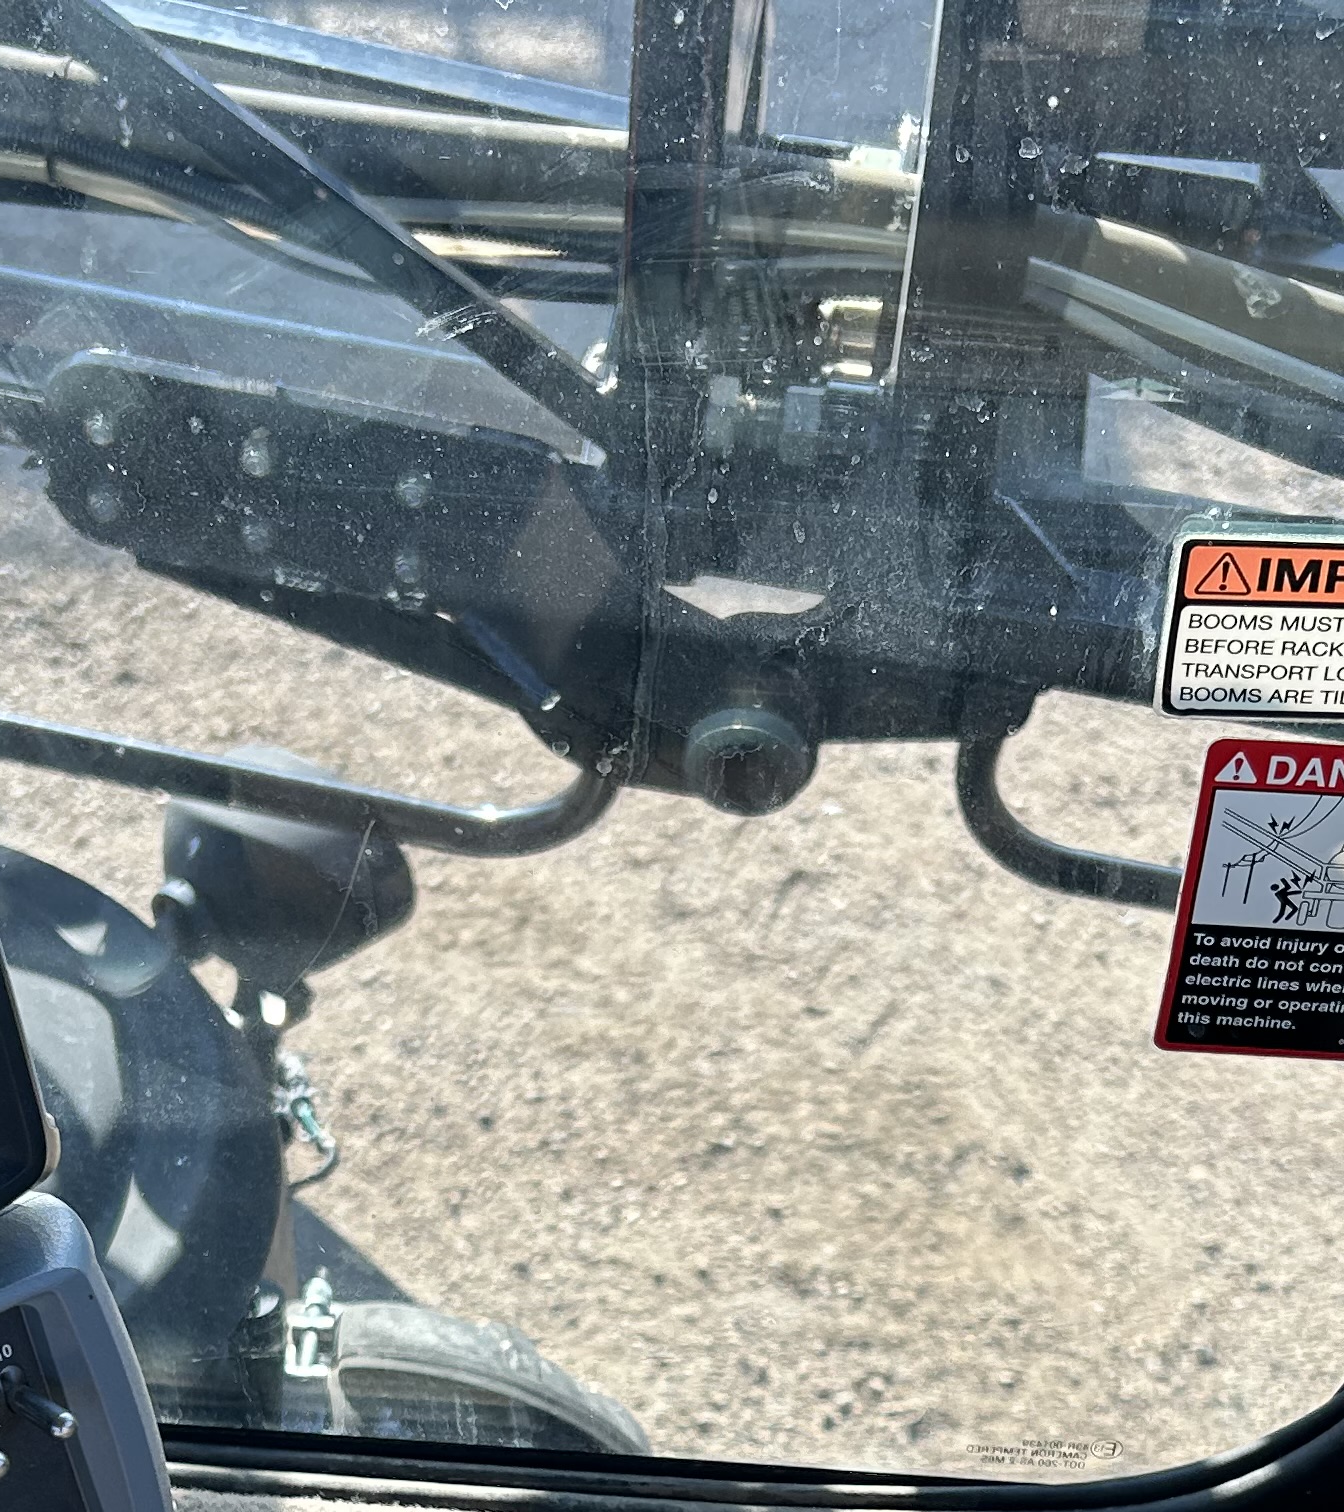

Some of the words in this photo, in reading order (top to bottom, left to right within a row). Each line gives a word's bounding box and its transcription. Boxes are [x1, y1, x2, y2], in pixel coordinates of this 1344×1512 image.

[1188, 614, 1273, 631] BOOMS
[1184, 639, 1274, 655] BEFORE
[1182, 663, 1318, 681] TRANSPORT
[1179, 686, 1262, 703] BOOMS
[1267, 689, 1313, 704] ARE
[1193, 933, 1215, 946] To
[1220, 935, 1270, 950] avoid
[1276, 937, 1329, 955] injury
[1189, 954, 1240, 969] death
[1245, 956, 1269, 970] do
[1273, 959, 1304, 972] not
[1185, 974, 1252, 988] electric
[1257, 976, 1299, 991] lines
[1181, 994, 1248, 1010] moving
[1253, 997, 1273, 1009] or
[1178, 1012, 1210, 1025] this
[1216, 1015, 1296, 1030] machine.
